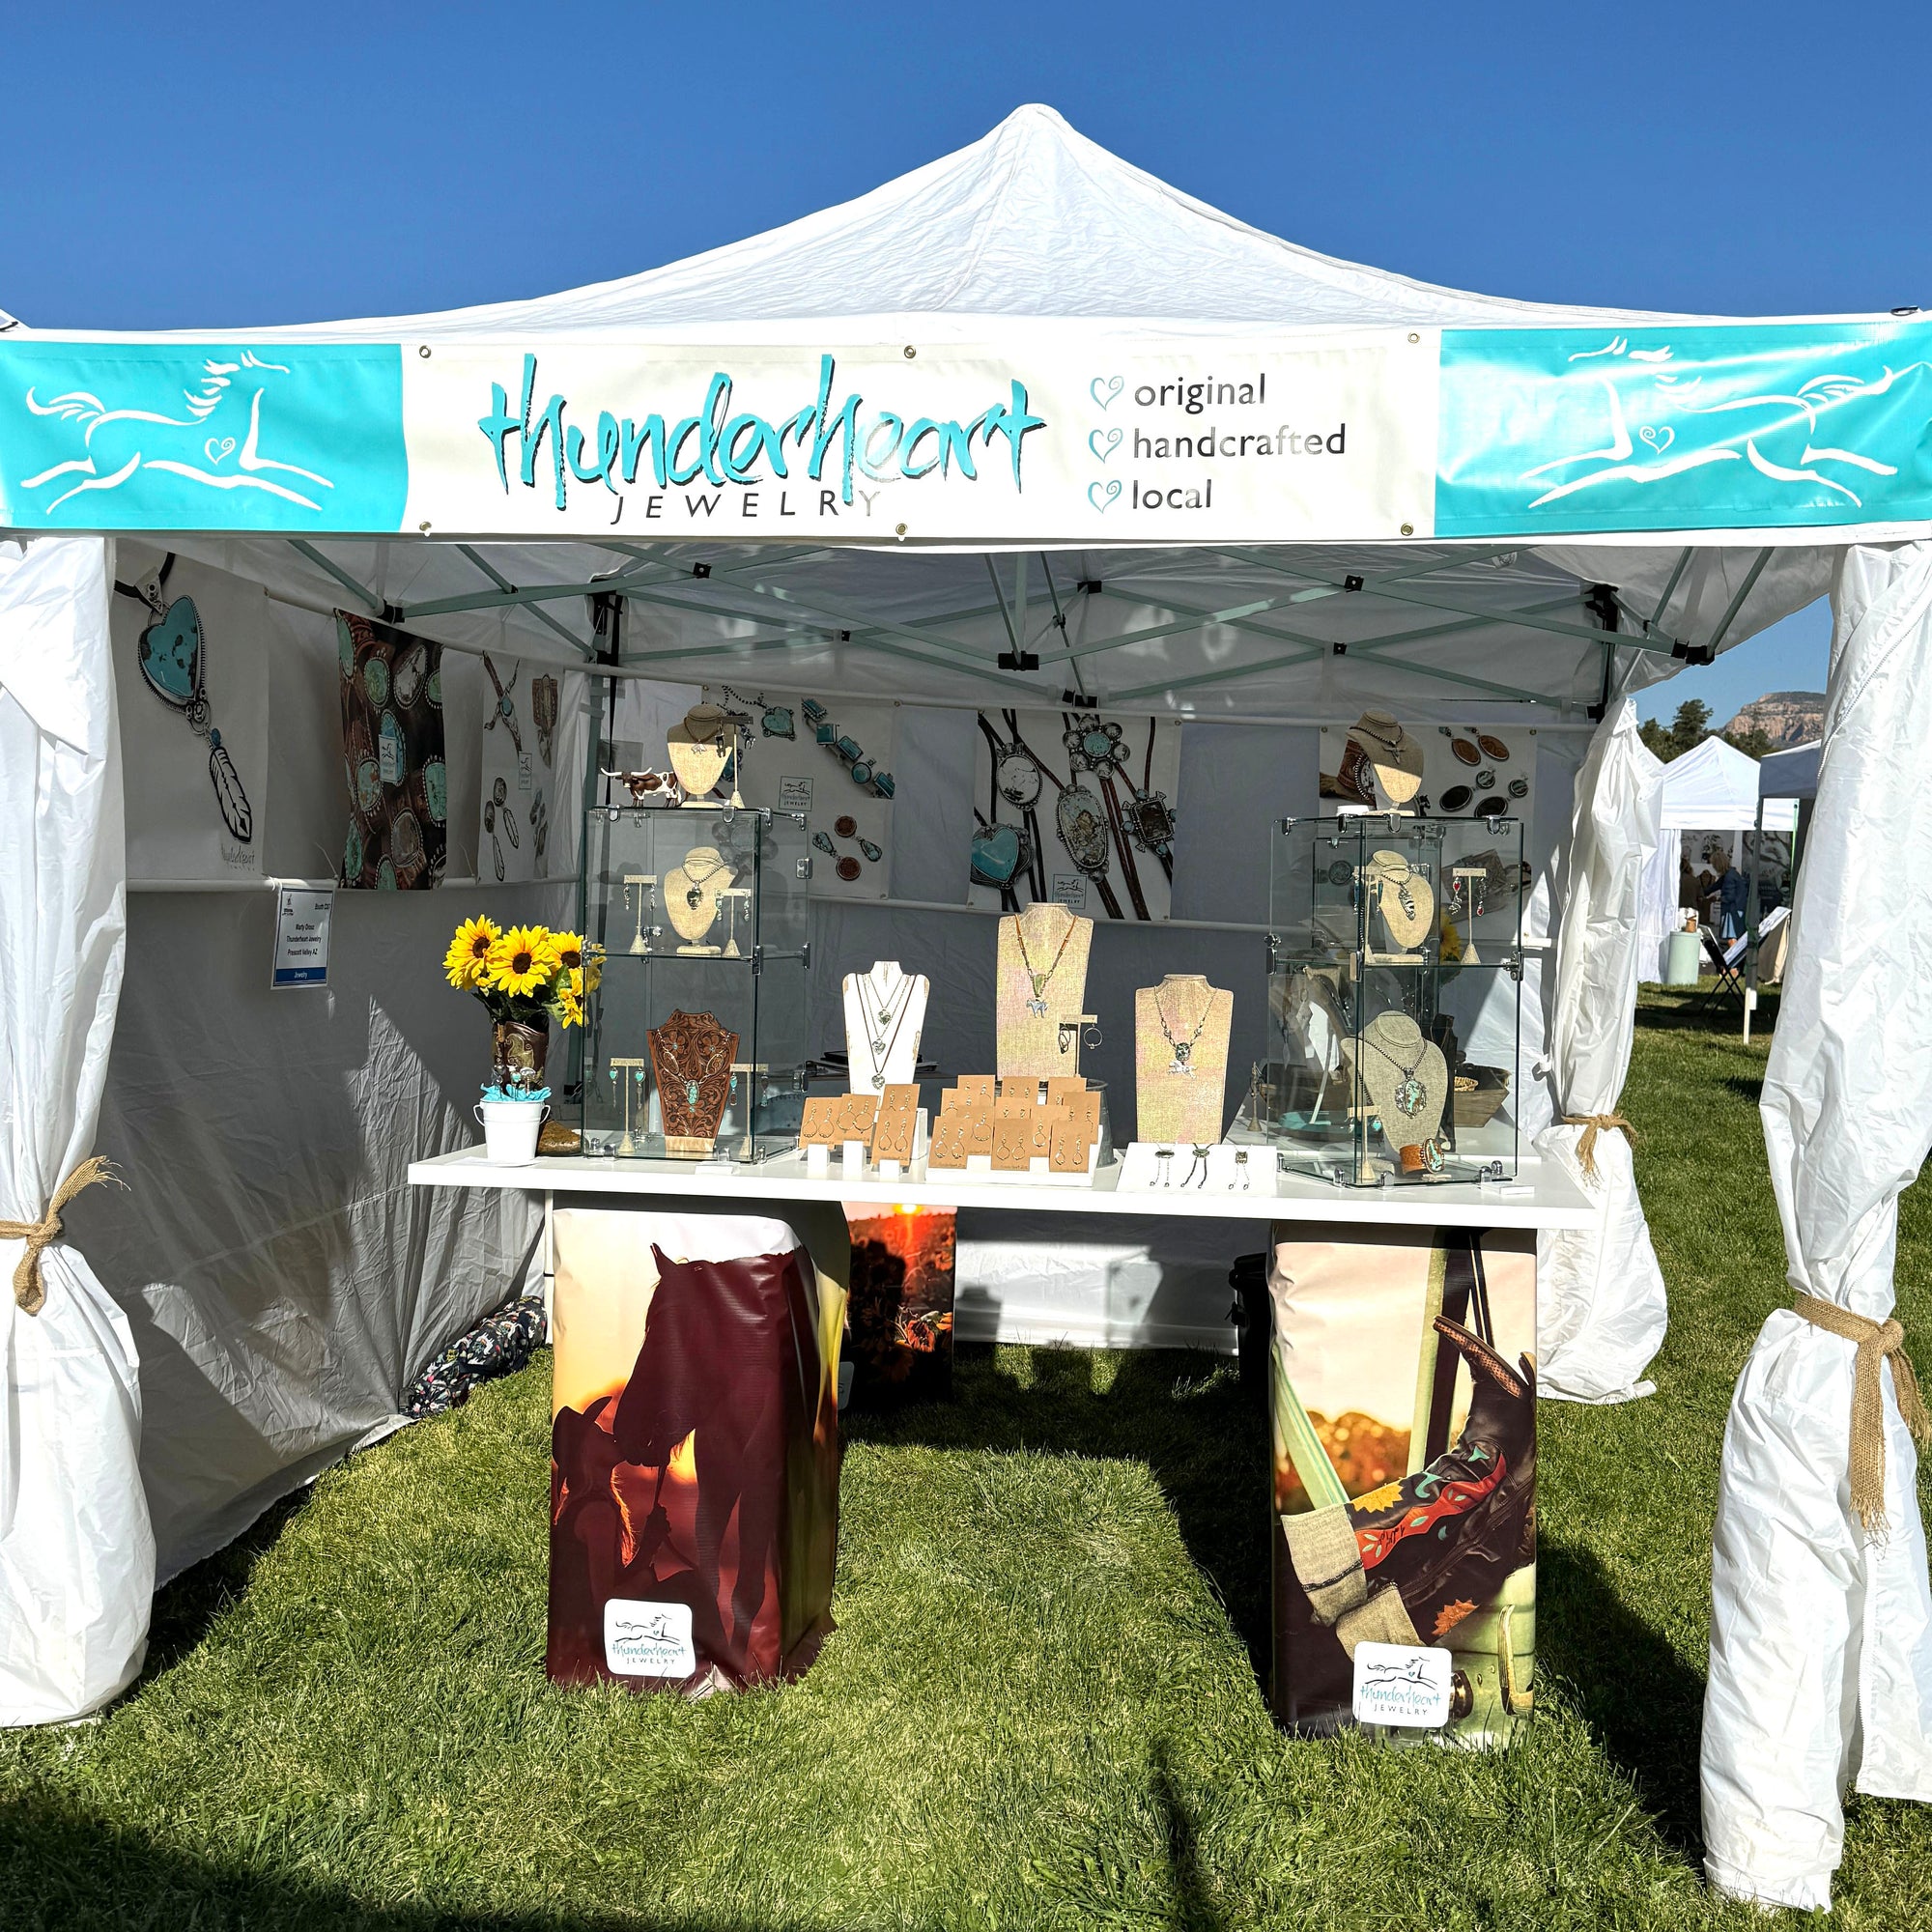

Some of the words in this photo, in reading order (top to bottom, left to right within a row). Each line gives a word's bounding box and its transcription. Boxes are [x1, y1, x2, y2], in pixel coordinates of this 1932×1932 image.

[1134, 373, 1265, 414] original
[478, 354, 1046, 510] thunderheart
[1133, 423, 1346, 459] handcrafted
[611, 490, 881, 525] JEWELRY
[1132, 479, 1212, 509] local
[294, 971, 307, 980] Jewelry
[1375, 1704, 1428, 1716] JEWELRY
